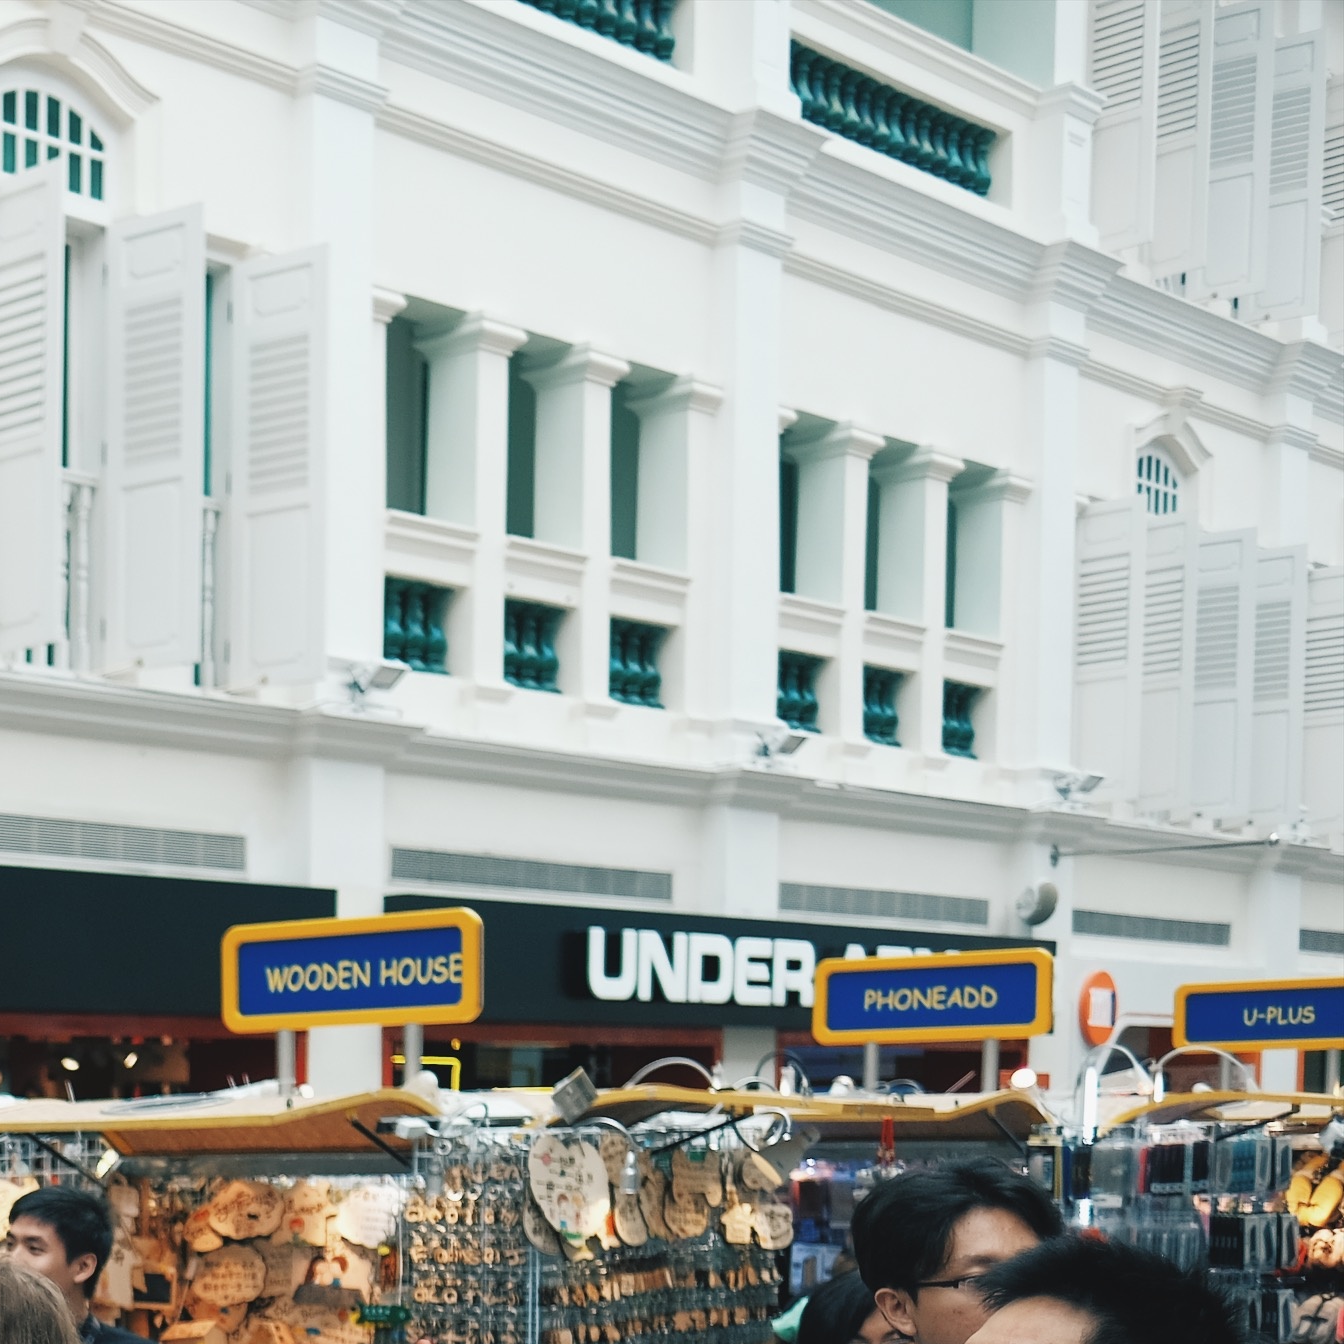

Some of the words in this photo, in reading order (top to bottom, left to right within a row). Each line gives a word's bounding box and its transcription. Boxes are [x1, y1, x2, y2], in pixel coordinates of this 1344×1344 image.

[265, 959, 371, 993] WOODEN
[379, 952, 463, 986] HOUSE
[586, 925, 817, 1008] UNDER
[864, 985, 999, 1012] PHONEADD
[1243, 1005, 1316, 1026] U-PLUS
